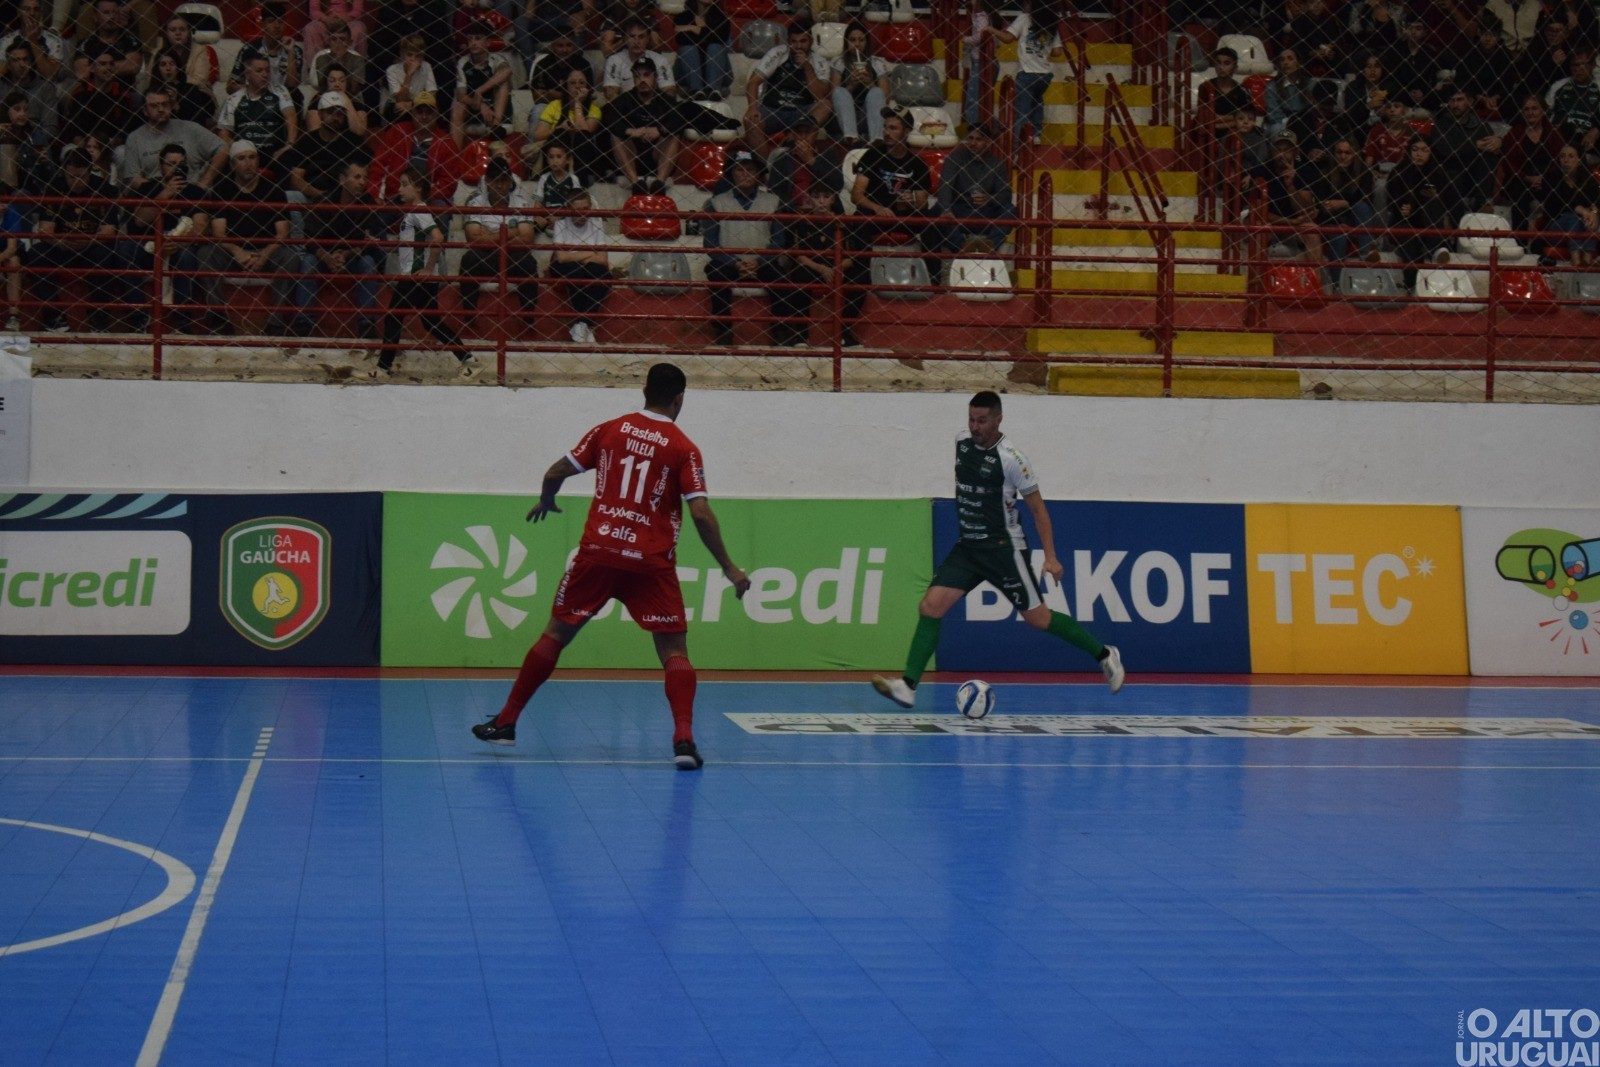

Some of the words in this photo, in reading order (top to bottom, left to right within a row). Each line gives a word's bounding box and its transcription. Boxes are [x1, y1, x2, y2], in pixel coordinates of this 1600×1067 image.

[620, 421, 669, 447] Brastelha
[625, 437, 656, 458] VILELA
[619, 455, 652, 504] 11
[597, 504, 652, 526] PLAXMETAL
[259, 534, 292, 548] LIGA
[611, 526, 637, 543] alfa
[240, 548, 311, 564] GAÚCHA
[566, 547, 888, 626] redi
[1257, 552, 1413, 627] TEC
